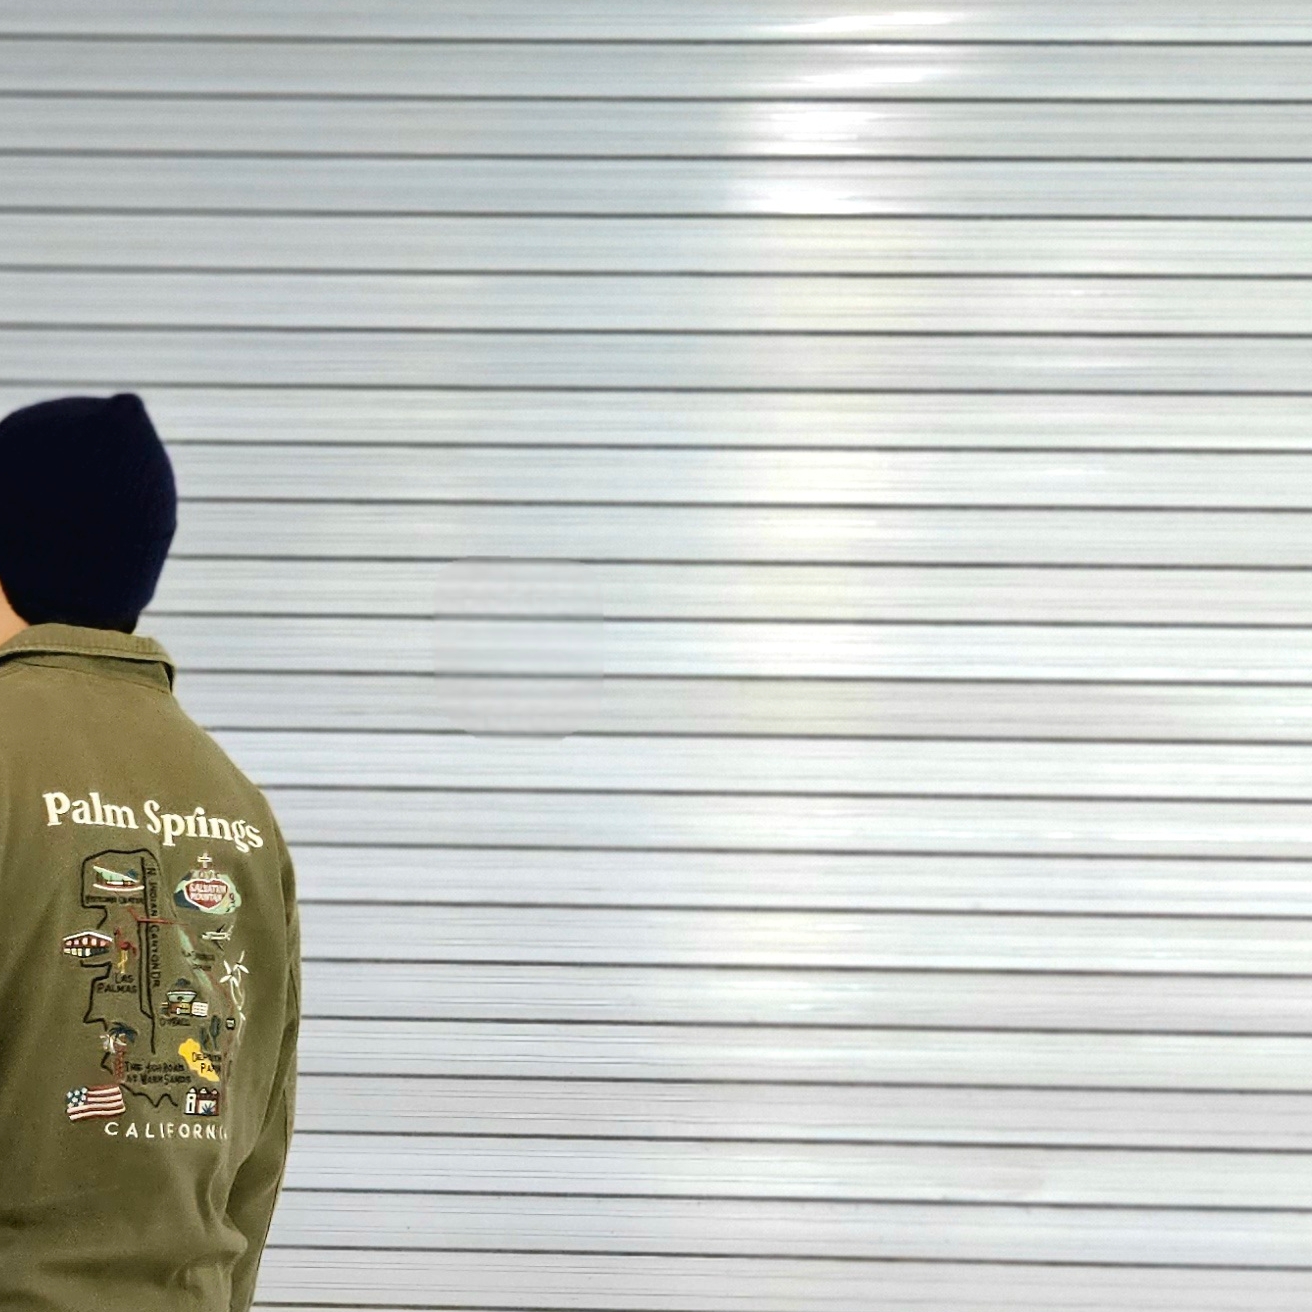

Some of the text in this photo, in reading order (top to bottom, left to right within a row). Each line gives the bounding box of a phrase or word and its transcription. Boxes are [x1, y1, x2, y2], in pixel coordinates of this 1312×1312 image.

[42, 791, 264, 853] Palm Springs
[104, 1121, 227, 1140] CALIFORNI
